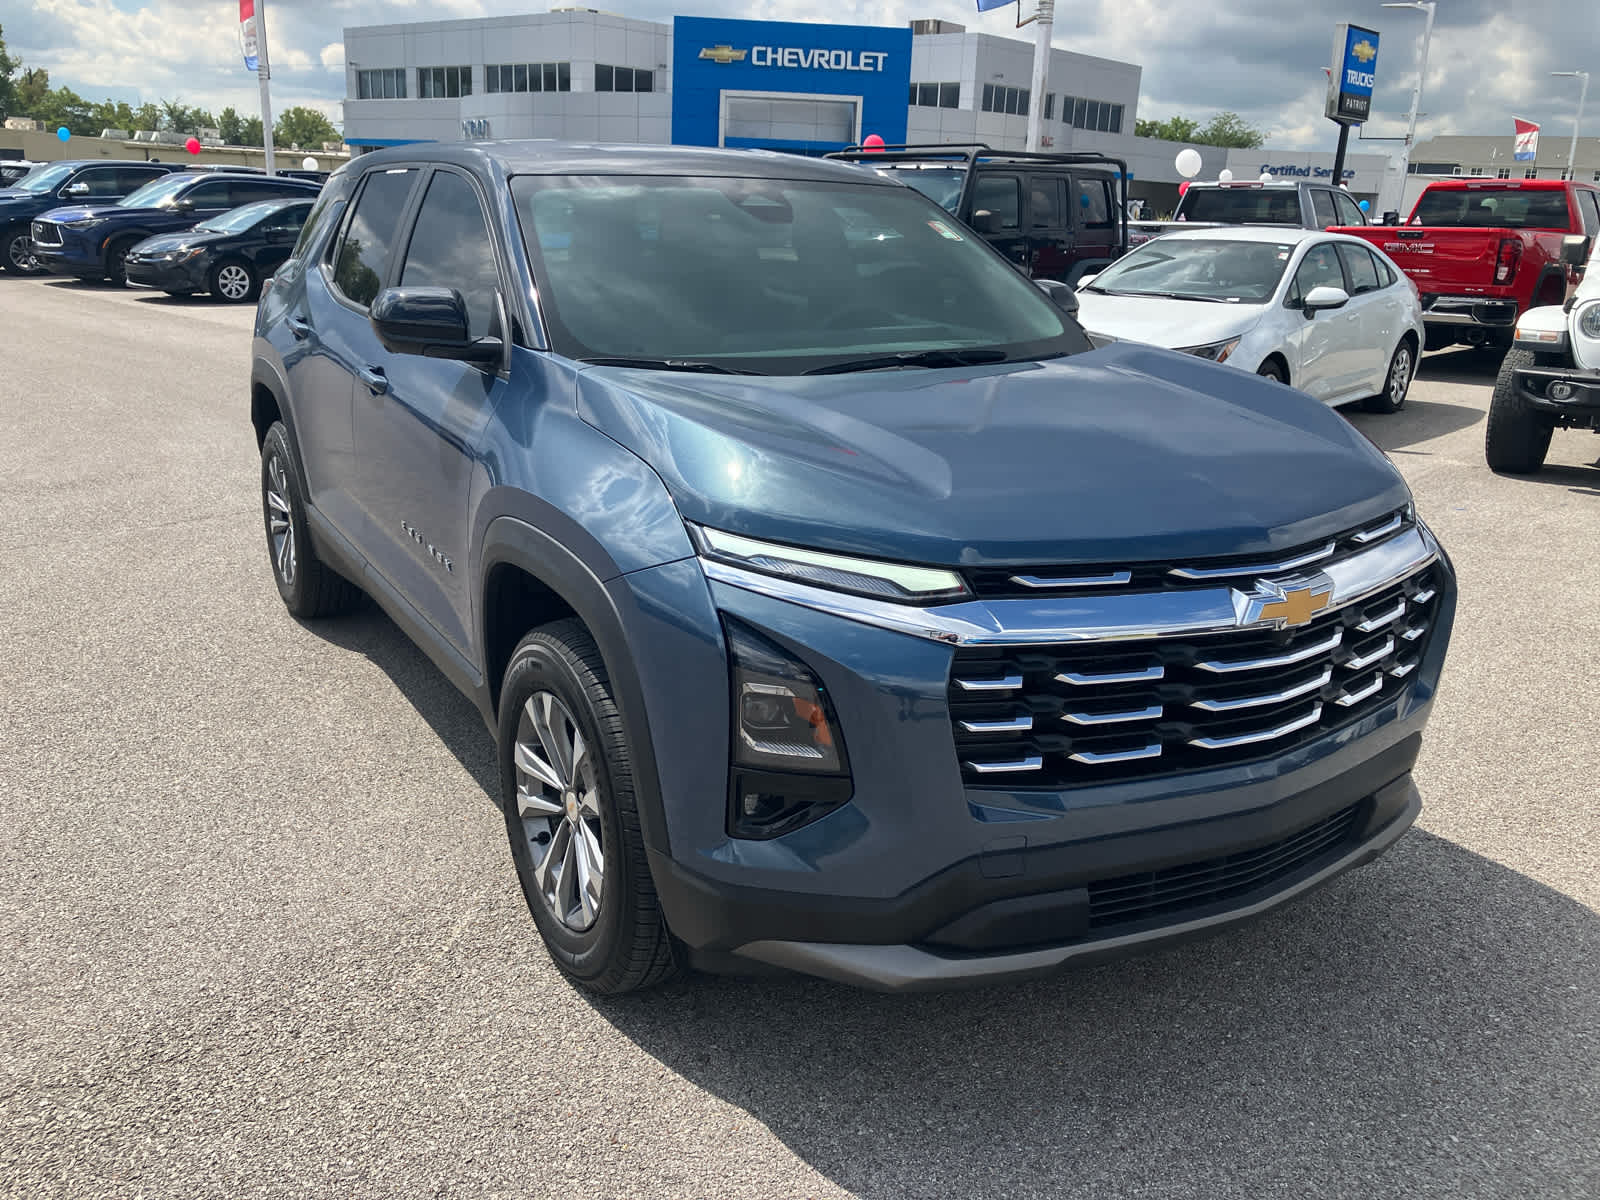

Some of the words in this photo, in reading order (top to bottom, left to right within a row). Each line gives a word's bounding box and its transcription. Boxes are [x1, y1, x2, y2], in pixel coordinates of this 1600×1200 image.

[751, 45, 889, 72] CHEVROLET
[1346, 69, 1375, 88] TRUCKS
[1260, 164, 1311, 177] Certified
[1313, 166, 1355, 179] Serce
[1384, 242, 1434, 254] GMC
